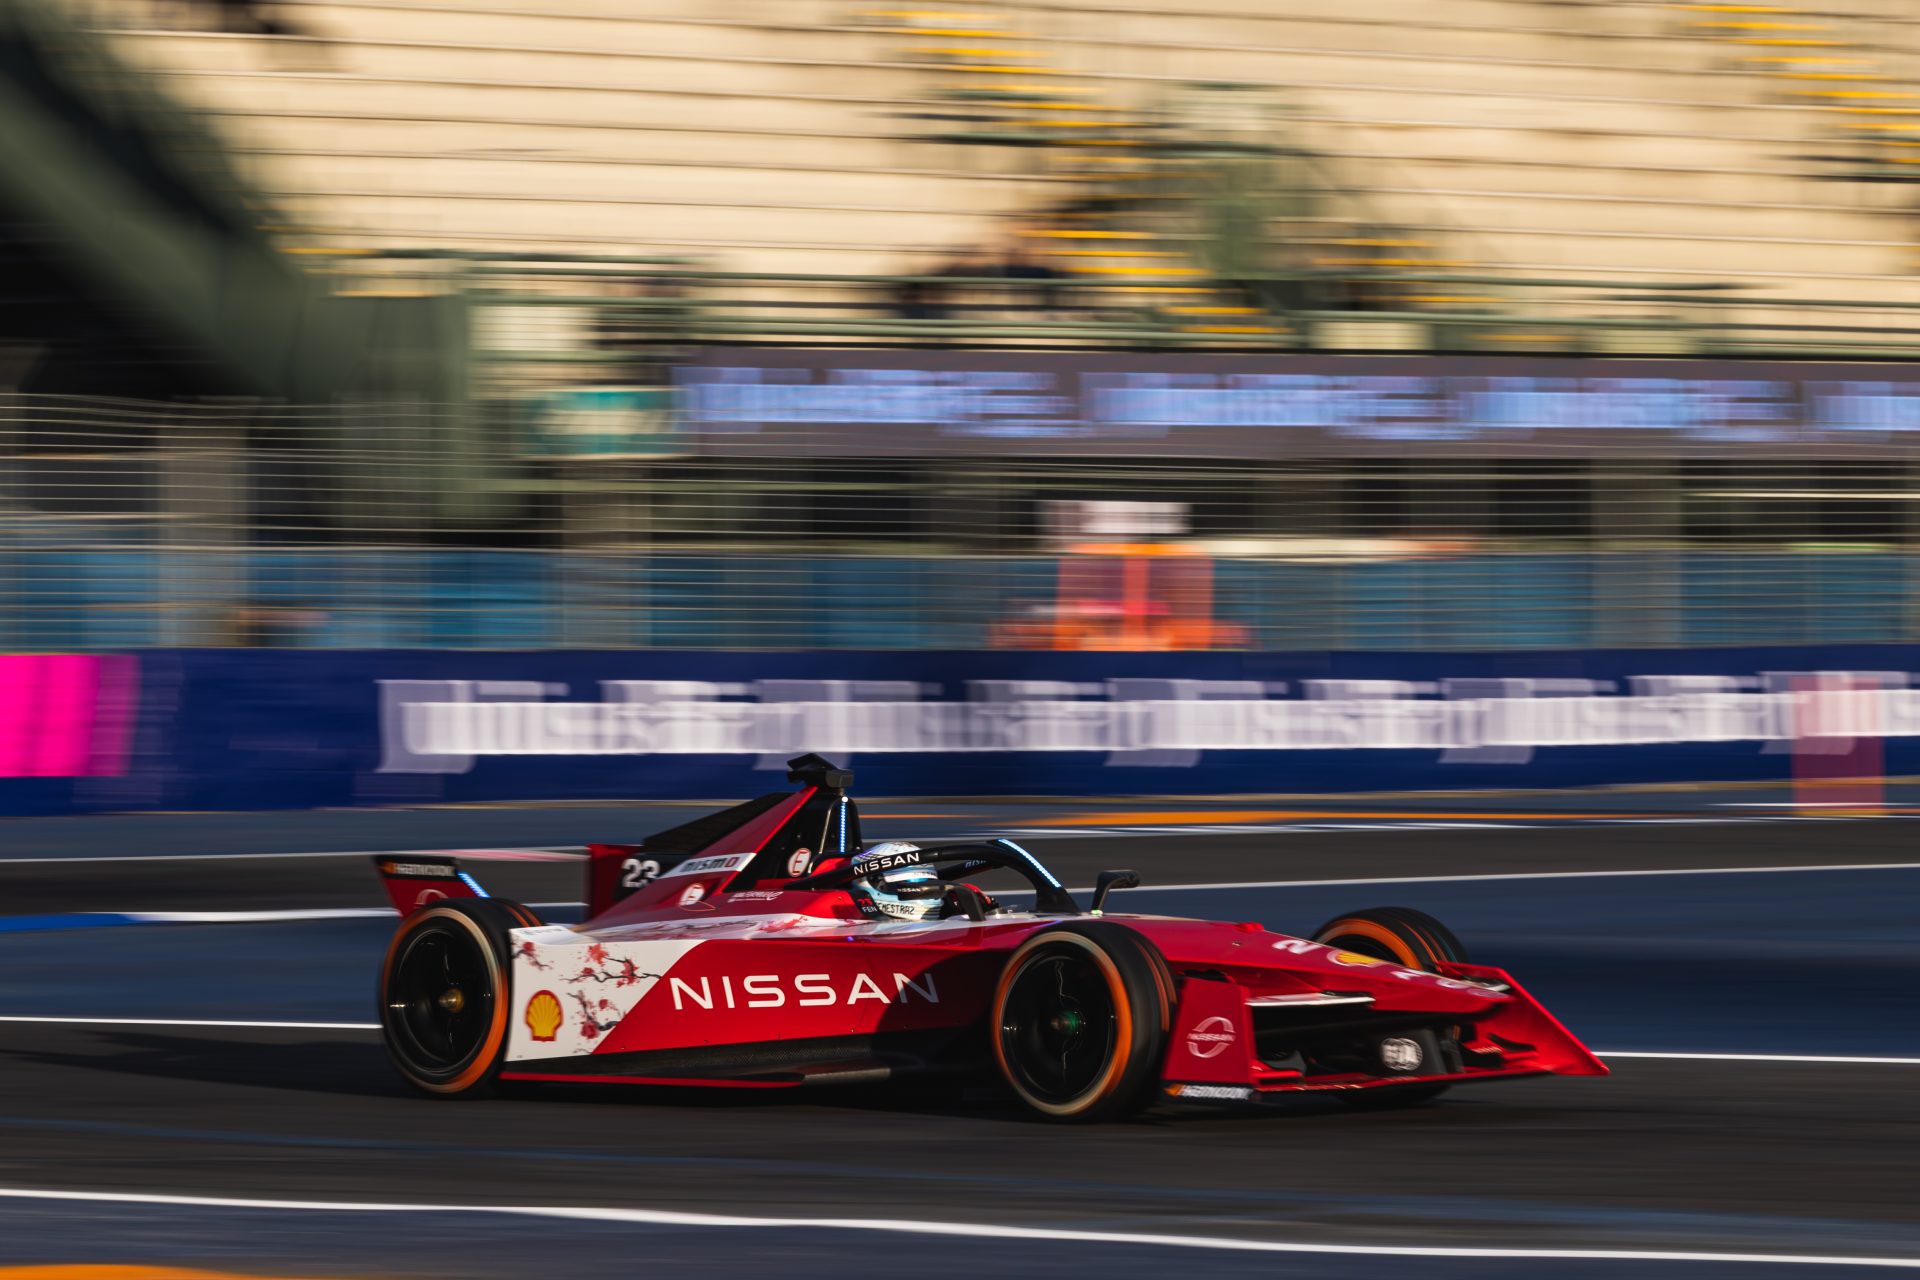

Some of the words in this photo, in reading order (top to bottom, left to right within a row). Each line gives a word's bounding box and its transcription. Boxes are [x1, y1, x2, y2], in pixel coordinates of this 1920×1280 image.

[621, 858, 661, 888] 23
[853, 852, 920, 875] NISSAN
[669, 972, 940, 1011] NISSAN
